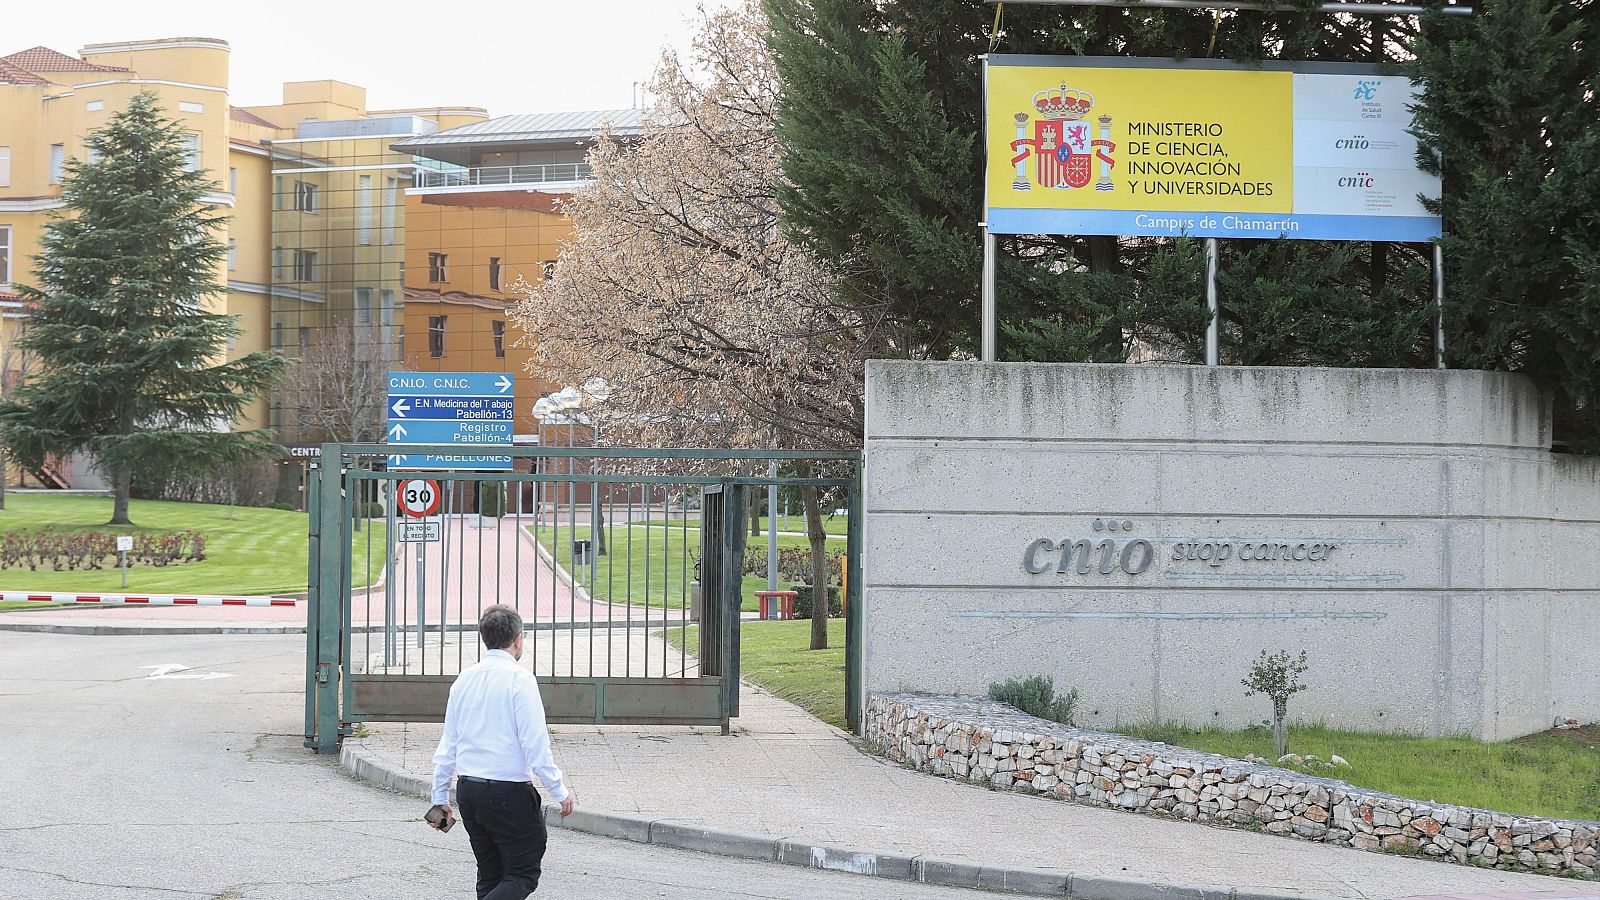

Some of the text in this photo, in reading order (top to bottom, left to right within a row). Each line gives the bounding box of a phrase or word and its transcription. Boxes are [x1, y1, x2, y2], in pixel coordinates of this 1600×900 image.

[1128, 122, 1223, 137] MINISTERIO
[1128, 141, 1150, 155] DE
[1155, 142, 1228, 158] CIENCIA,
[1128, 159, 1241, 176] INNOVACIÓN
[1128, 180, 1273, 196] Y UNIVERSIDADES
[1135, 214, 1299, 232] Campus de Chamartín
[390, 378, 471, 389] C.N.I.O. C.N.I.C.
[415, 398, 432, 408] E.N.
[434, 399, 468, 408] Medicina
[470, 399, 482, 408] del
[456, 409, 513, 419] Pabellón-13
[460, 422, 507, 433] Registro
[453, 432, 512, 442] Pabellón-4
[291, 447, 323, 457] CENTR
[407, 489, 431, 504] 30
[1171, 541, 1232, 567] stop
[1238, 541, 1337, 562] cancer
